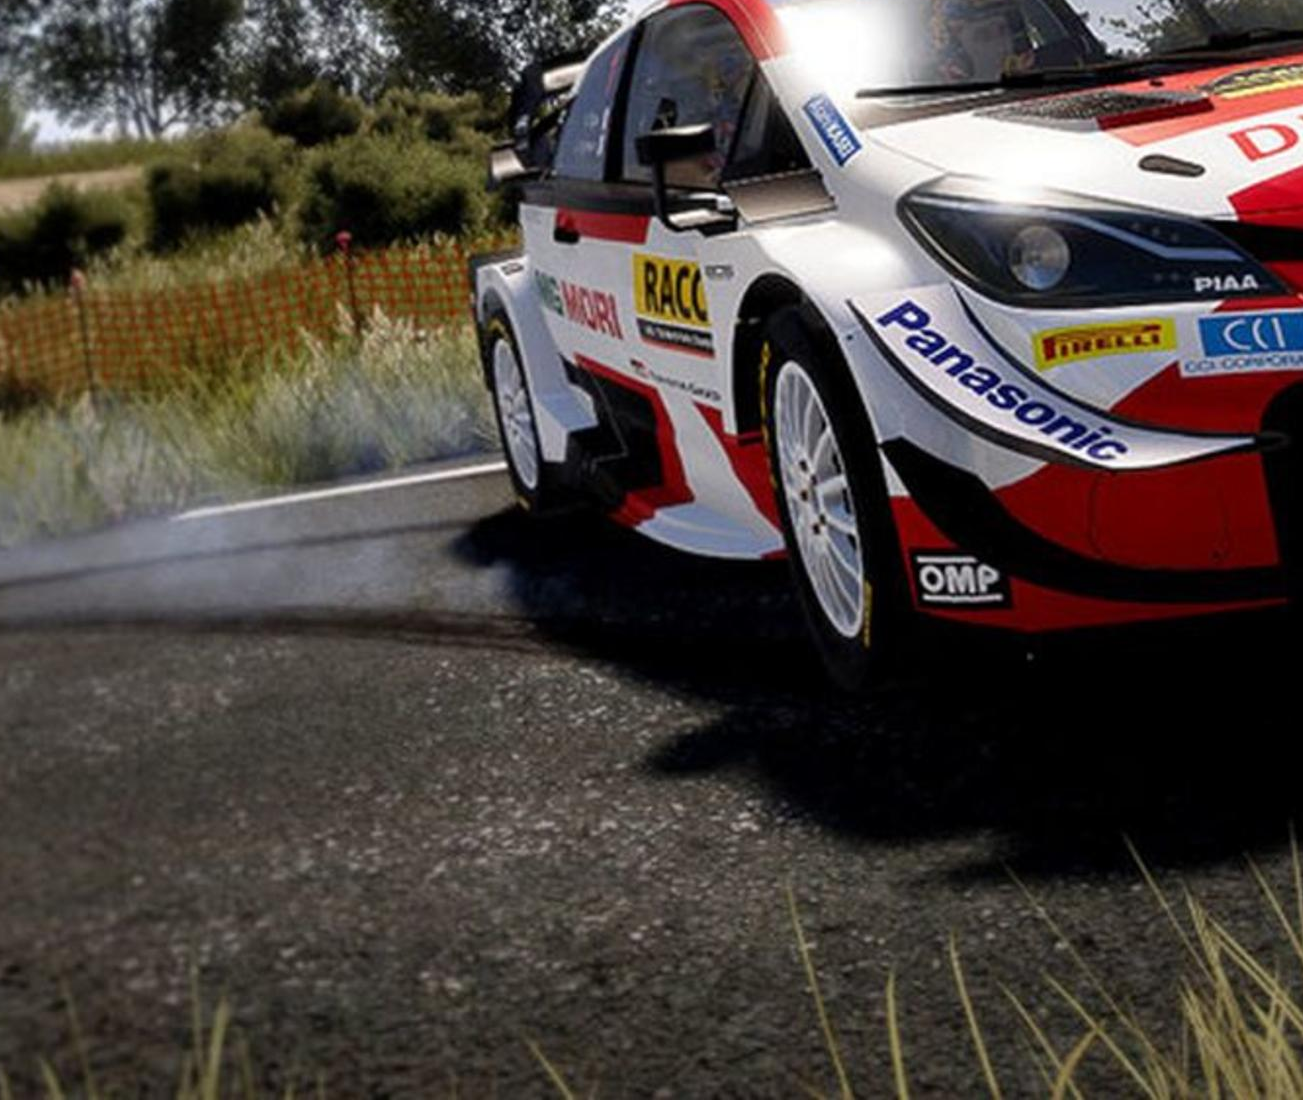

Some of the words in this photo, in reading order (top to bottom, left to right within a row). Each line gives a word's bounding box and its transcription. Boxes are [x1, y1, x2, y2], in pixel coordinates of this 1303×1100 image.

[644, 261, 708, 322] RACC
[1195, 274, 1259, 293] PIAA
[561, 280, 624, 340] MORI
[1042, 324, 1161, 361] PIRELLI
[1224, 317, 1286, 350] CCI
[877, 300, 1128, 460] Panasonic
[920, 565, 999, 594] OMP
